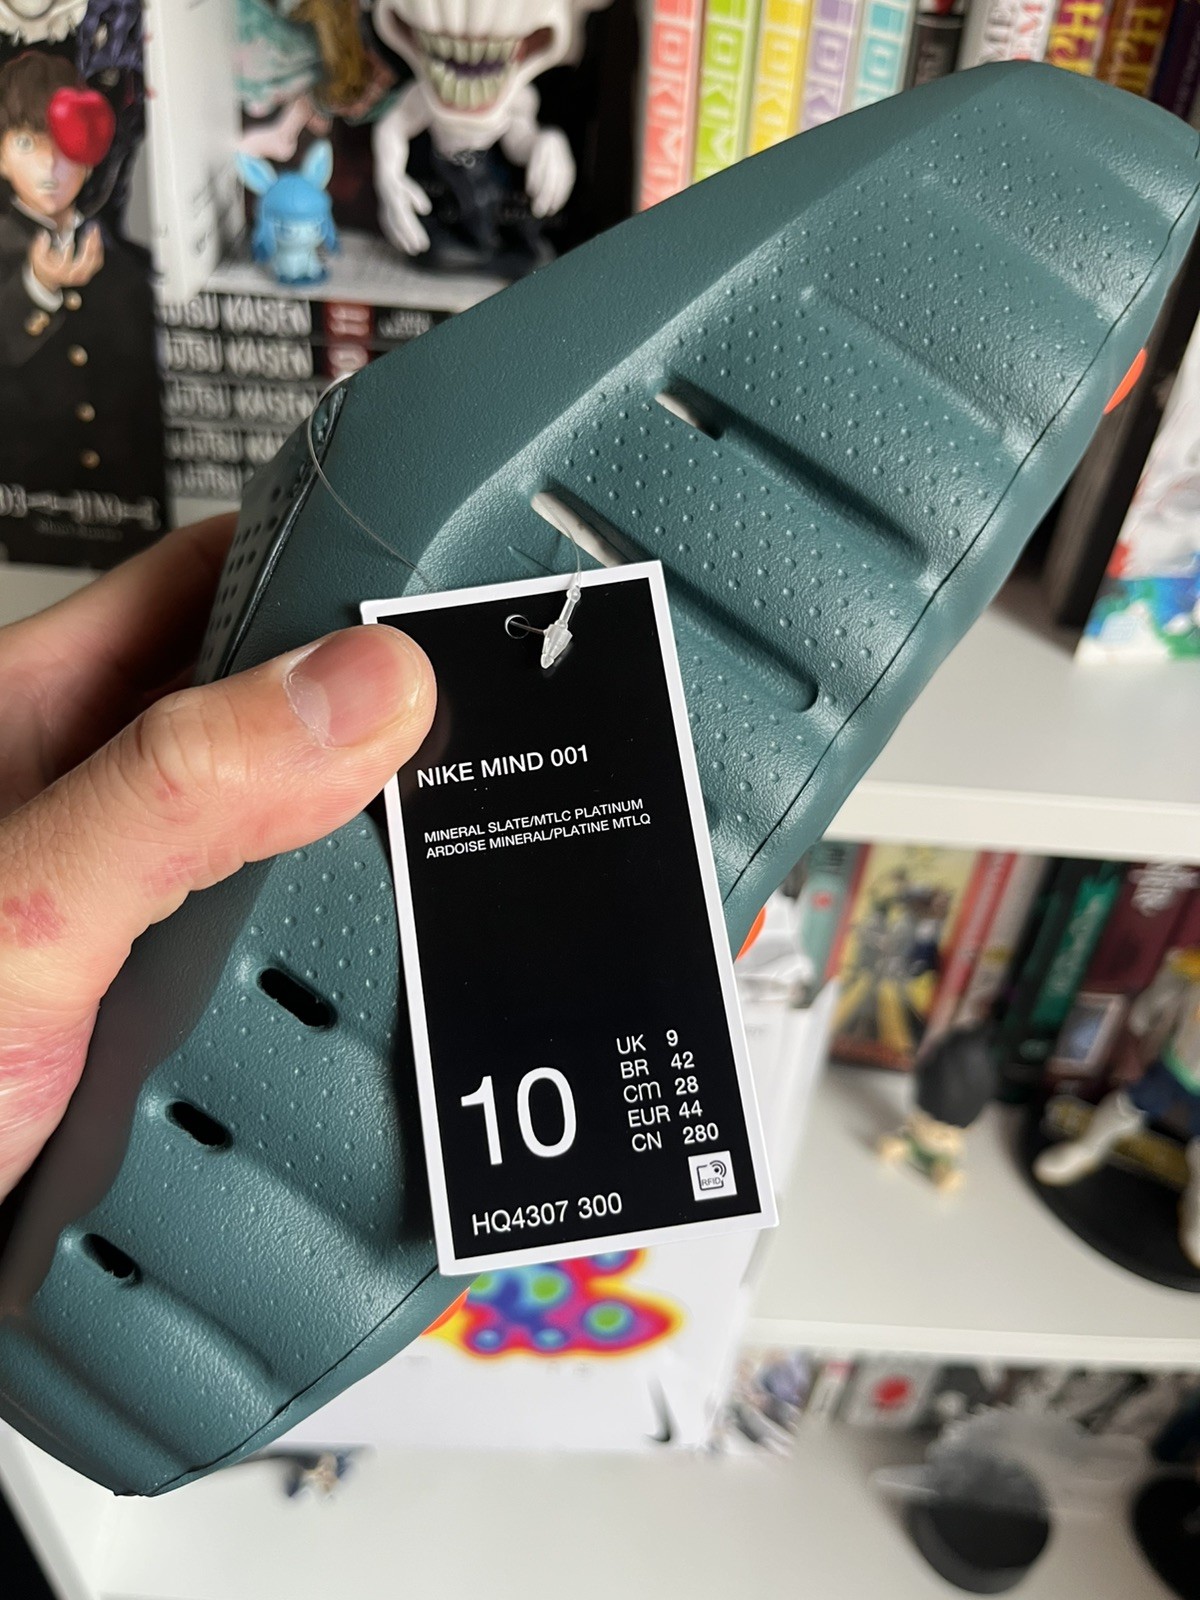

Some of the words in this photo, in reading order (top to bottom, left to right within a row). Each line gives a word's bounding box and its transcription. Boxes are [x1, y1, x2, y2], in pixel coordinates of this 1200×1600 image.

[224, 336, 314, 380] KAISEN
[416, 761, 475, 788] NIKE
[480, 751, 544, 779] MIND
[550, 744, 588, 767] 001
[424, 824, 486, 843] MINERAL
[488, 809, 572, 834] SLATE/MTLC
[574, 798, 644, 820] PLATINUM
[426, 839, 487, 859] ARDOISE
[489, 819, 610, 849] MINERAL/PLATINE
[612, 813, 651, 830] MTLQ
[616, 1033, 647, 1055] UK
[665, 1029, 679, 1047] 9
[620, 1058, 650, 1080] BR
[670, 1050, 695, 1070] 42
[674, 1075, 699, 1096] 28
[460, 1066, 577, 1166] 10
[627, 1104, 671, 1128] EUR
[678, 1099, 703, 1119] 44
[631, 1130, 663, 1153] CN
[682, 1122, 719, 1145] 280
[701, 1177, 721, 1186] RFID
[471, 1199, 569, 1236] HQ4307
[577, 1192, 623, 1220] 300
